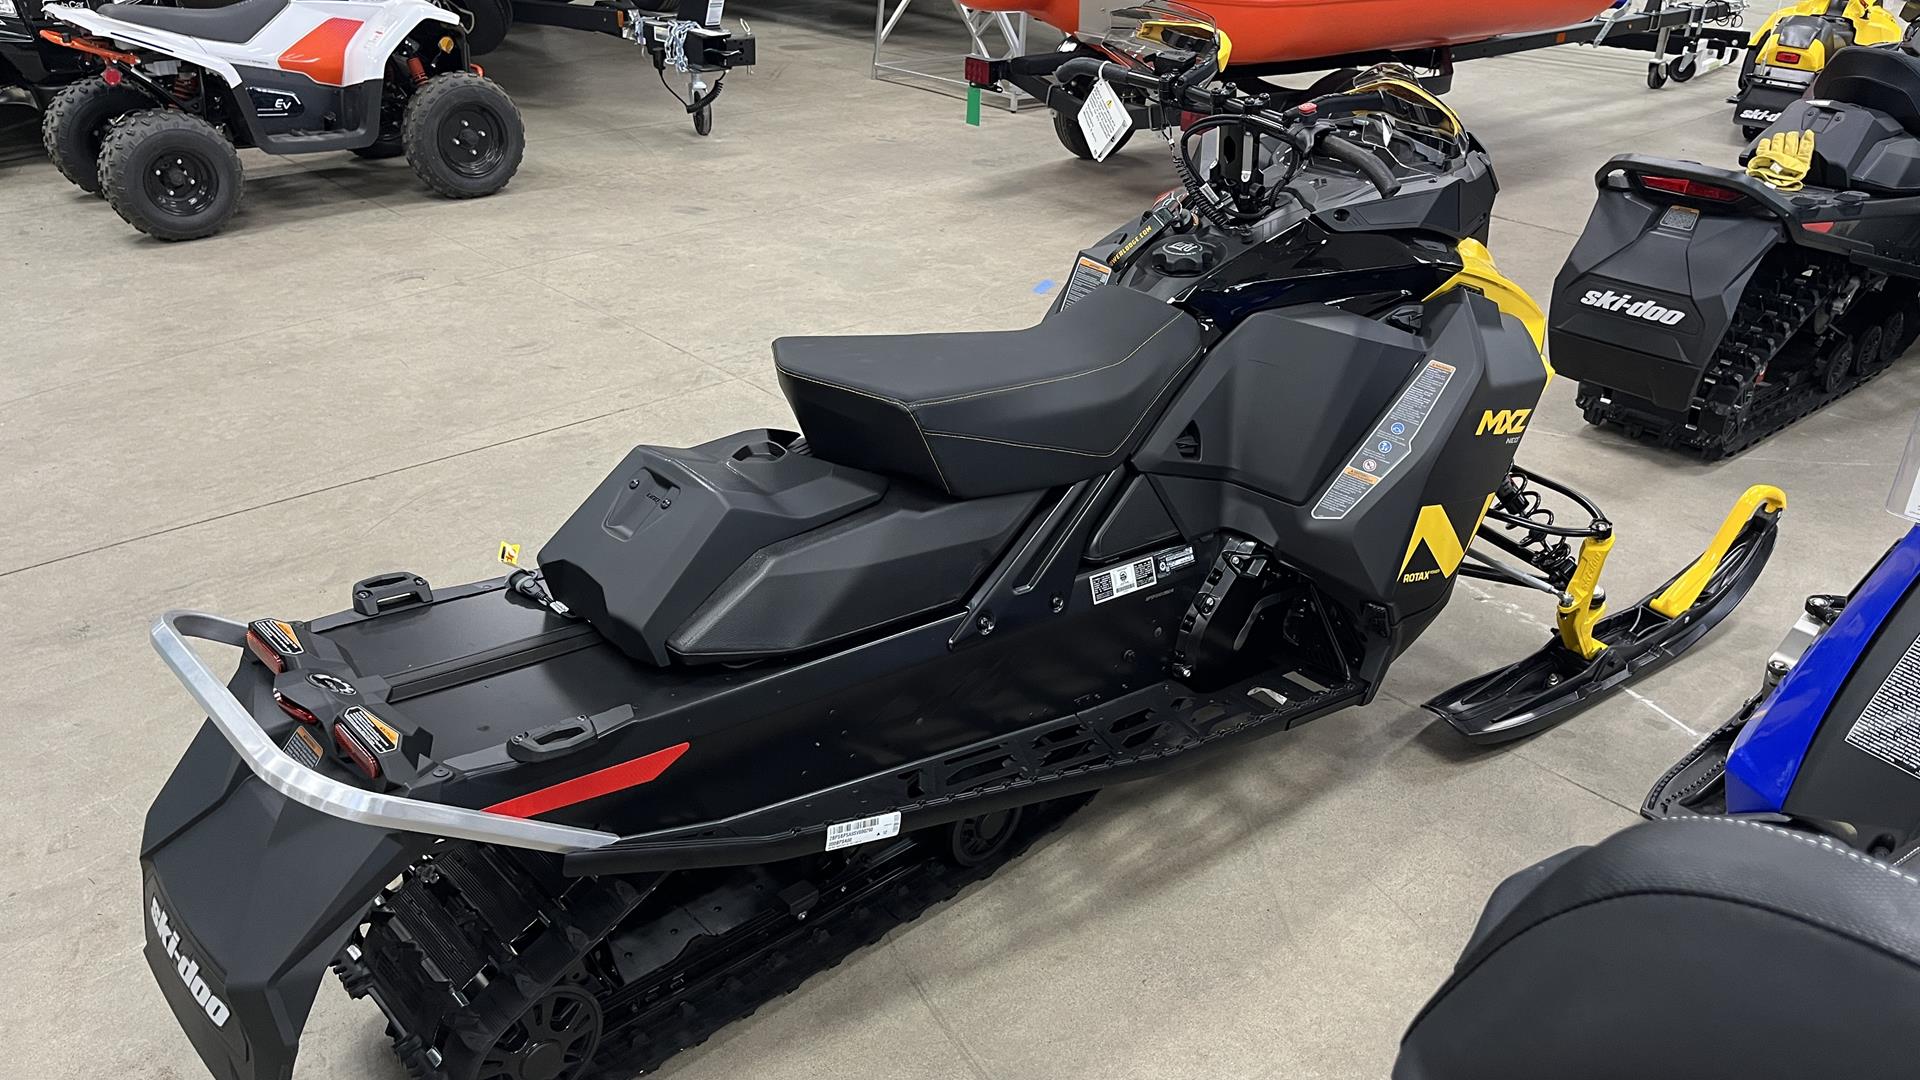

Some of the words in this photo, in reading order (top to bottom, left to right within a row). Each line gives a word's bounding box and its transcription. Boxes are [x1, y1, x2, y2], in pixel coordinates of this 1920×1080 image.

[1580, 290, 1686, 326] ski-doo
[1475, 408, 1532, 436] MXZ
[1403, 571, 1430, 583] ROTAX
[151, 896, 231, 1027] ski-doo
